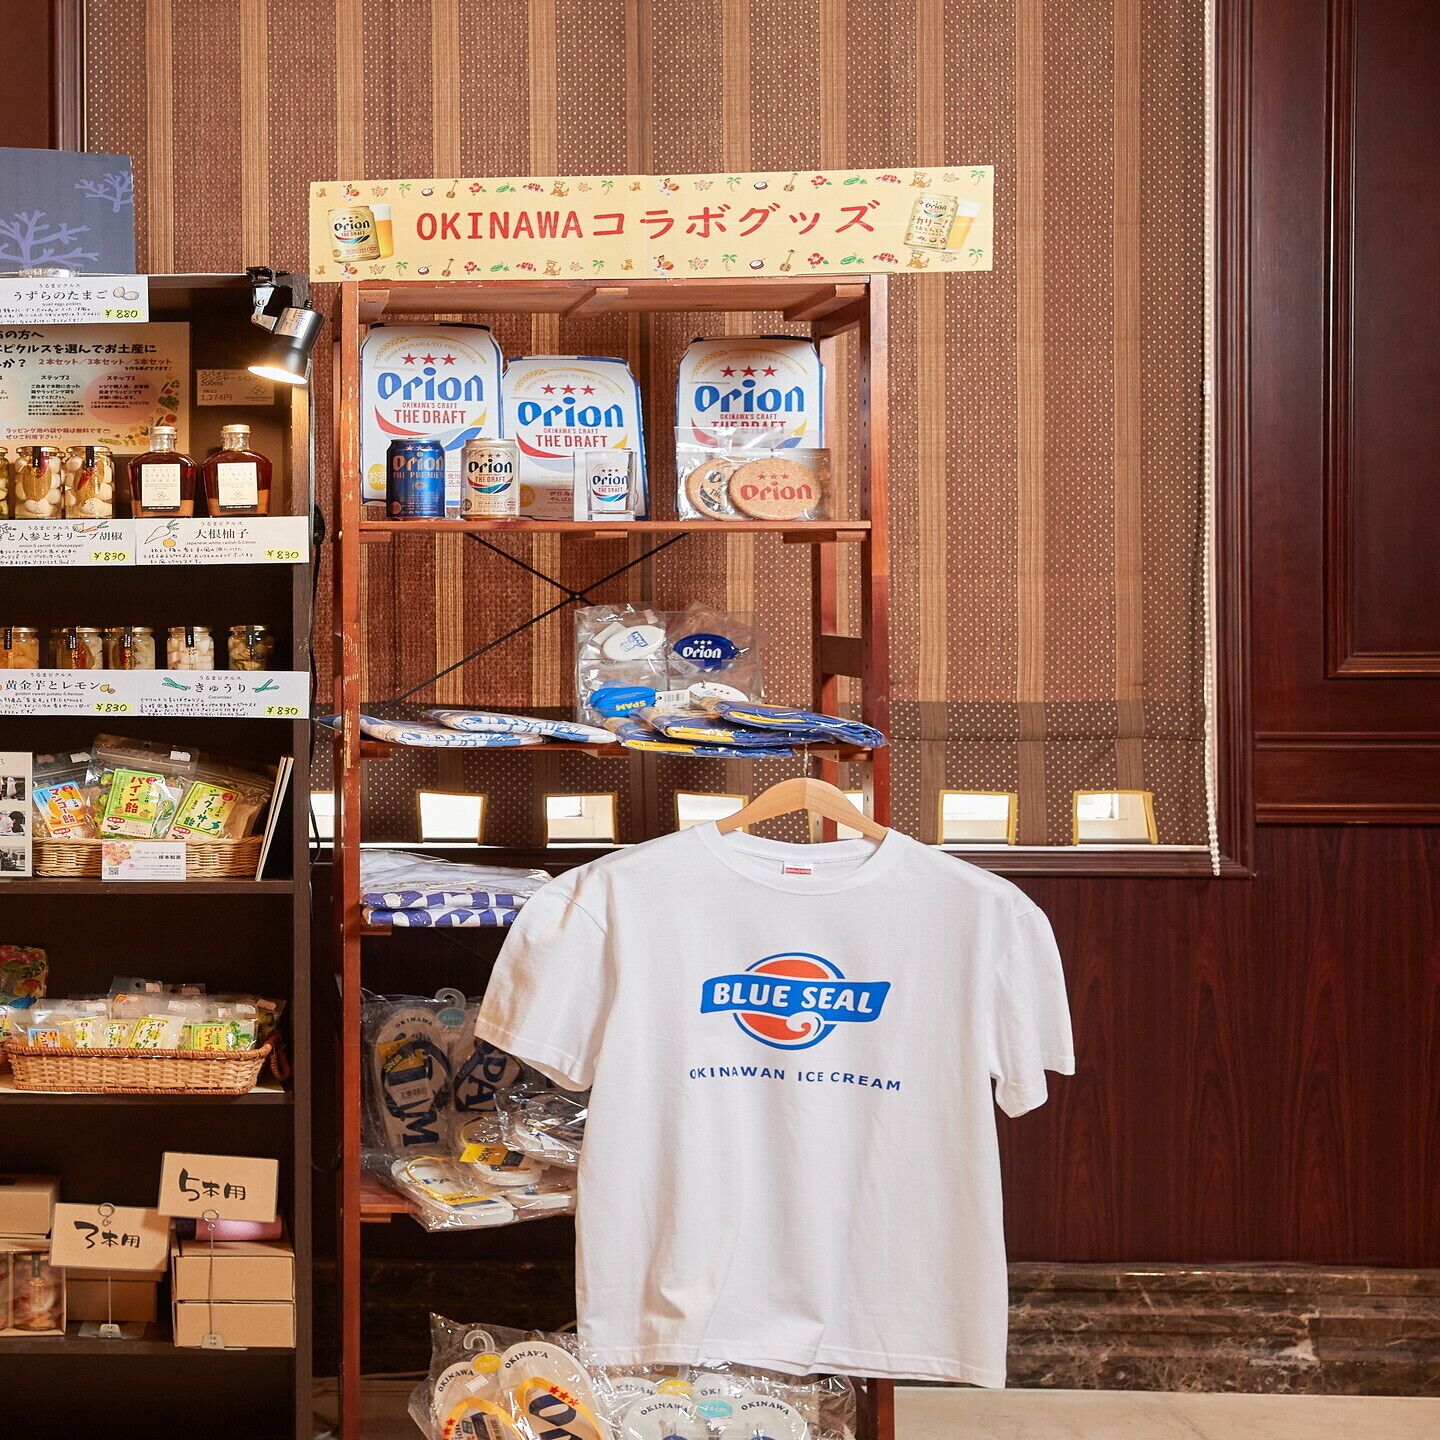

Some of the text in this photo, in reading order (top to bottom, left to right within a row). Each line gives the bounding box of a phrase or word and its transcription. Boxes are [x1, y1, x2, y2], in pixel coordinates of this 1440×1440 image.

[416, 199, 881, 241] OKINAWAコラボグッズ
[13, 290, 108, 301] うずらのたまご
[394, 409, 467, 424] THE DRAFT
[535, 434, 608, 448] THE DRAFT
[195, 527, 249, 540] 大根柚子
[93, 552, 127, 562] ¥830
[266, 550, 300, 560] ¥830
[5, 679, 101, 691] 黄金芋とレモン
[194, 682, 247, 693] きゅうり
[96, 703, 128, 713] ¥830
[267, 706, 299, 716] ¥830
[124, 776, 146, 814] パイン飴
[712, 982, 873, 1014] BLUE SEAL
[394, 1016, 433, 1028] OKINAWA
[689, 1066, 902, 1092] OKINAWAN ICE CREAM
[177, 1168, 247, 1202] 5本用
[73, 1220, 141, 1250] 3本用
[504, 1349, 550, 1370] OKINAWA
[437, 1368, 475, 1393] OKINAWA
[640, 1401, 689, 1416] OKINAWA
[741, 1400, 790, 1416] OKINAWA
